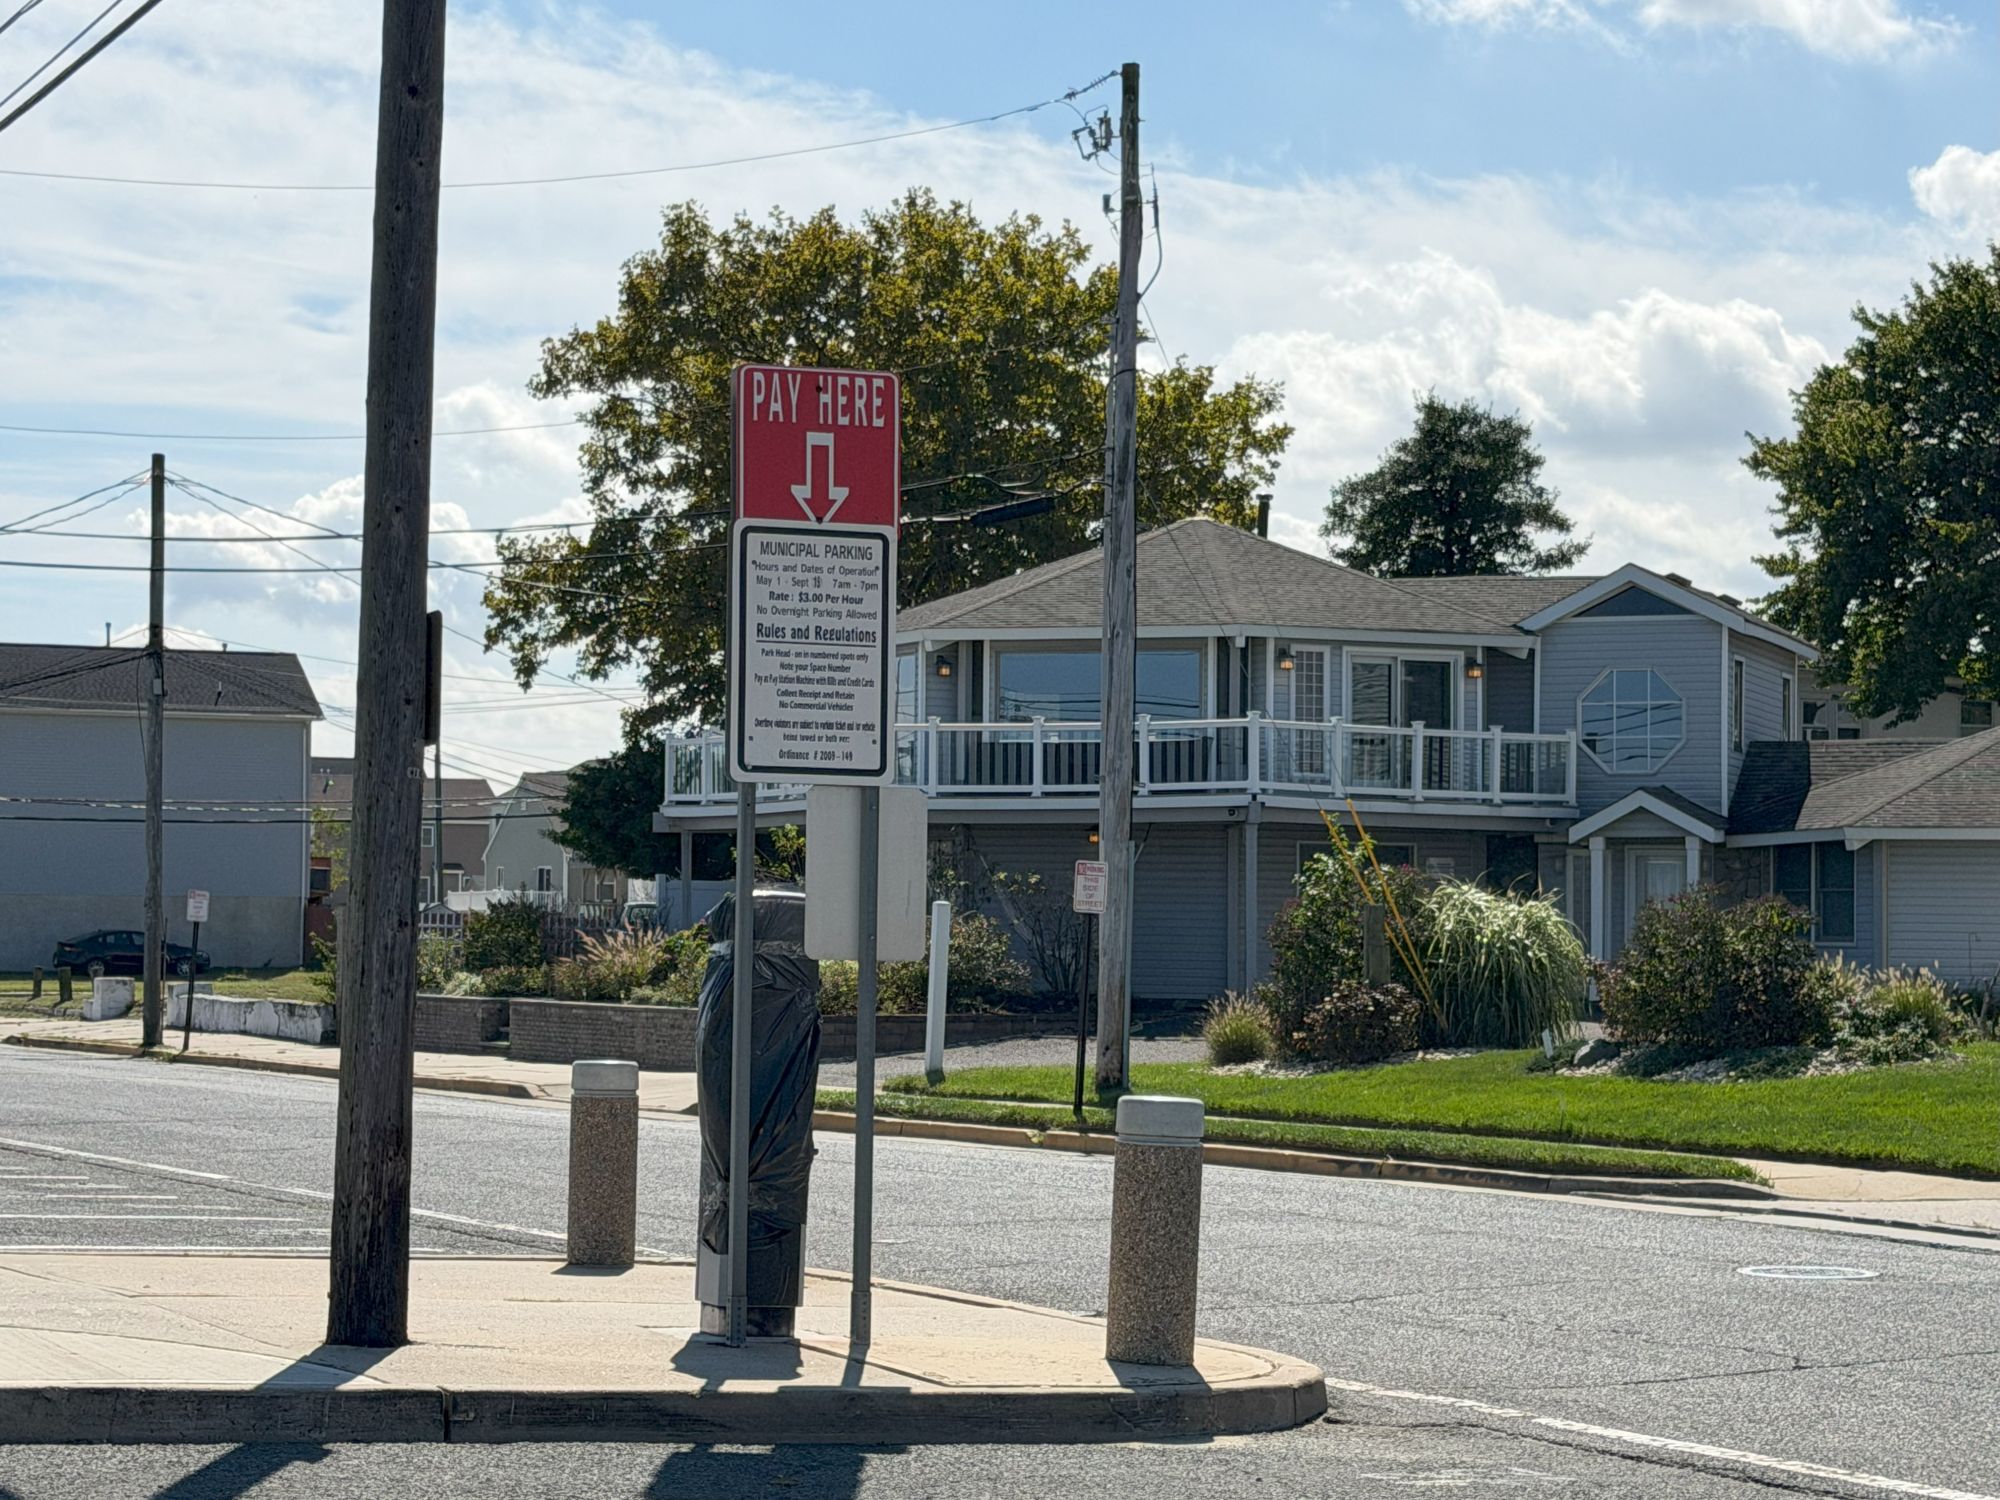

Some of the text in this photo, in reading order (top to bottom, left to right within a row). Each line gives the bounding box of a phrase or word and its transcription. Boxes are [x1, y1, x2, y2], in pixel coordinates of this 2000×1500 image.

[753, 371, 885, 427] PAY HERE
[760, 541, 872, 560] MUNICIPAL PARKING
[755, 562, 877, 576] Hours and Dates of Operation
[756, 575, 772, 587] May
[777, 576, 780, 585] 1
[792, 577, 809, 588] Sept
[833, 579, 850, 588] 7am
[860, 581, 878, 592] 7pm
[799, 592, 823, 603] $3.00
[826, 594, 840, 604] Per
[842, 595, 864, 604] Hour
[757, 605, 877, 620] No Overnight Parking Allowed
[757, 623, 876, 642] Rules and Regulations
[762, 648, 774, 656] Park
[776, 649, 790, 657] Head
[810, 651, 839, 660] numbered
[841, 653, 854, 662] spots
[856, 653, 868, 663] only
[780, 662, 851, 673] Note your Space Number
[754, 673, 762, 686] Pay
[847, 678, 860, 686] Credit
[777, 689, 797, 698] Collect
[798, 690, 821, 700] Receipt
[835, 691, 855, 699] Retain
[790, 701, 826, 710] Commercial
[828, 702, 853, 711] Vehicles
[779, 750, 809, 760] Ordinance
